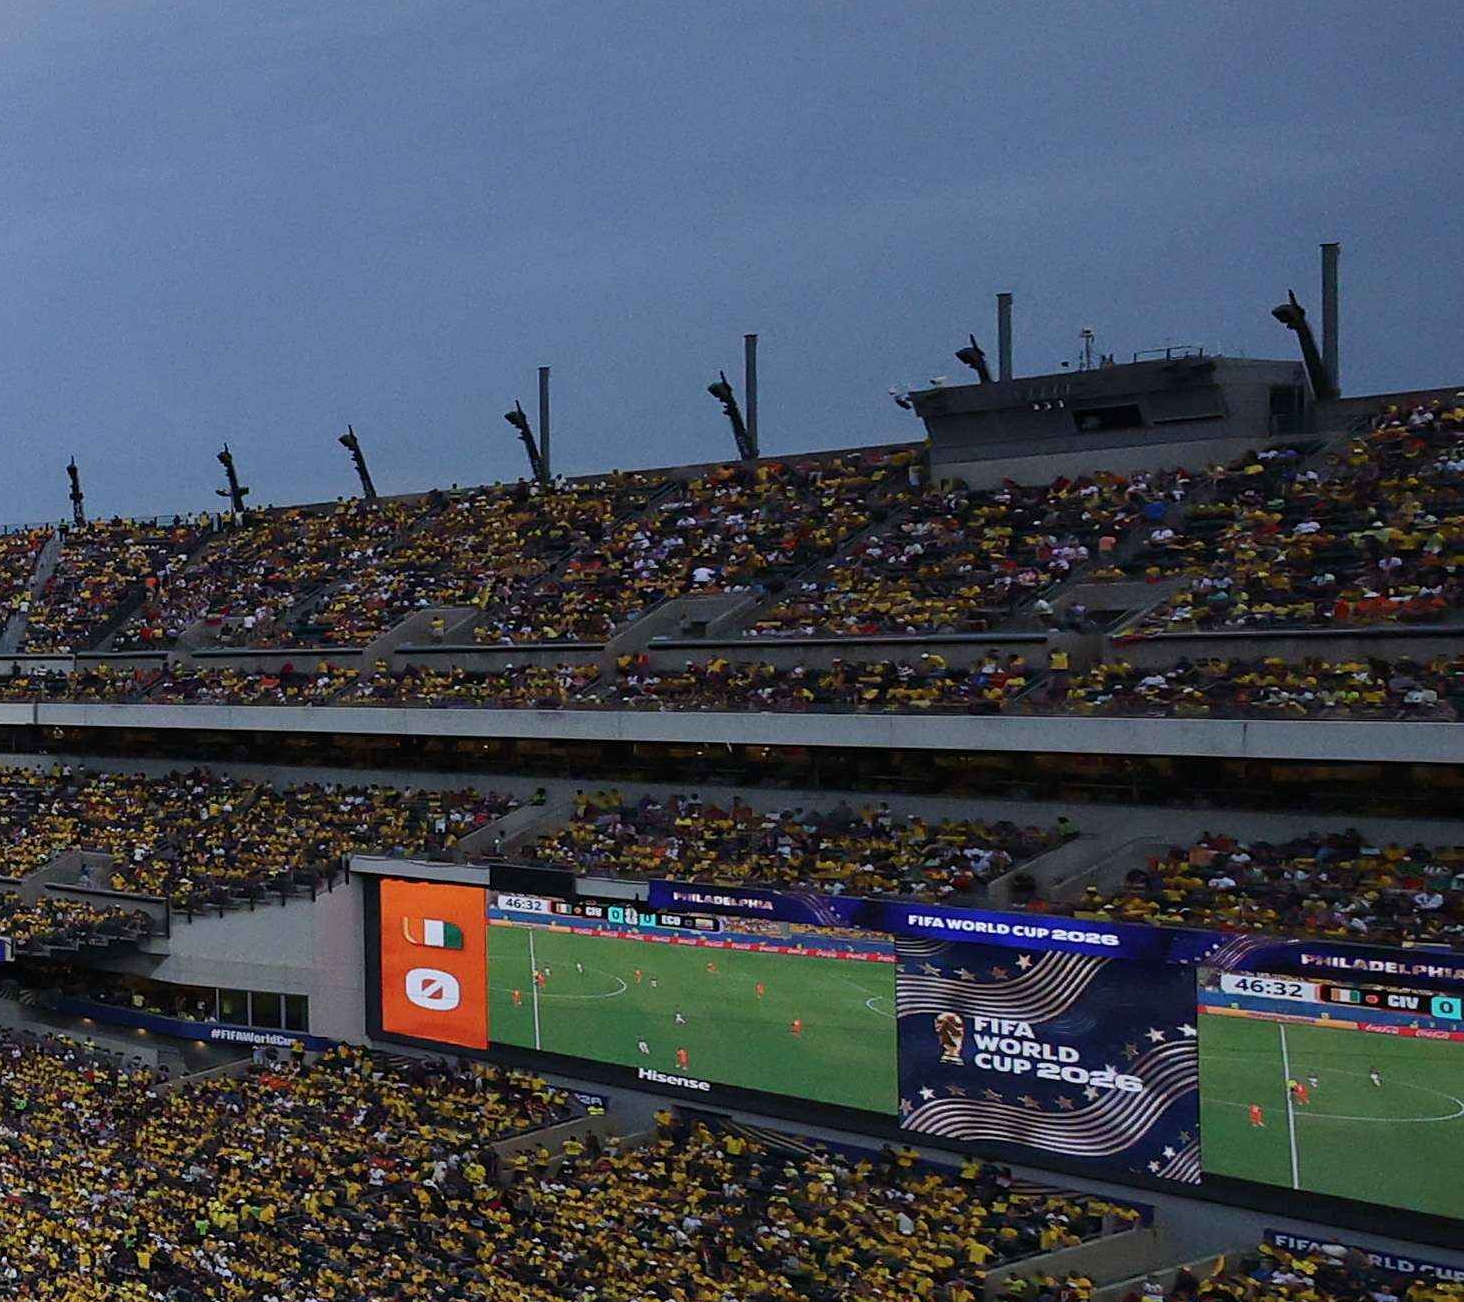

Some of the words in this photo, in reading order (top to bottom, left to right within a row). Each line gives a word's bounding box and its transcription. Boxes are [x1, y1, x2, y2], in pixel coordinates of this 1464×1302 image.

[506, 898, 542, 911] 46:32
[673, 891, 773, 911] PHILADELPHIA
[908, 915, 944, 929] FIFA
[946, 918, 1010, 935] WORLD
[1012, 925, 1049, 939] CUP
[1051, 930, 1120, 946] 2026
[1301, 953, 1464, 981] PHILADELPHIA
[1235, 978, 1303, 998] 46:32
[974, 1017, 1036, 1039] FIFA
[973, 1033, 1080, 1063] WORLD
[638, 1068, 711, 1092] Hisense
[974, 1053, 1032, 1075] CUP
[1036, 1062, 1145, 1092] 2026
